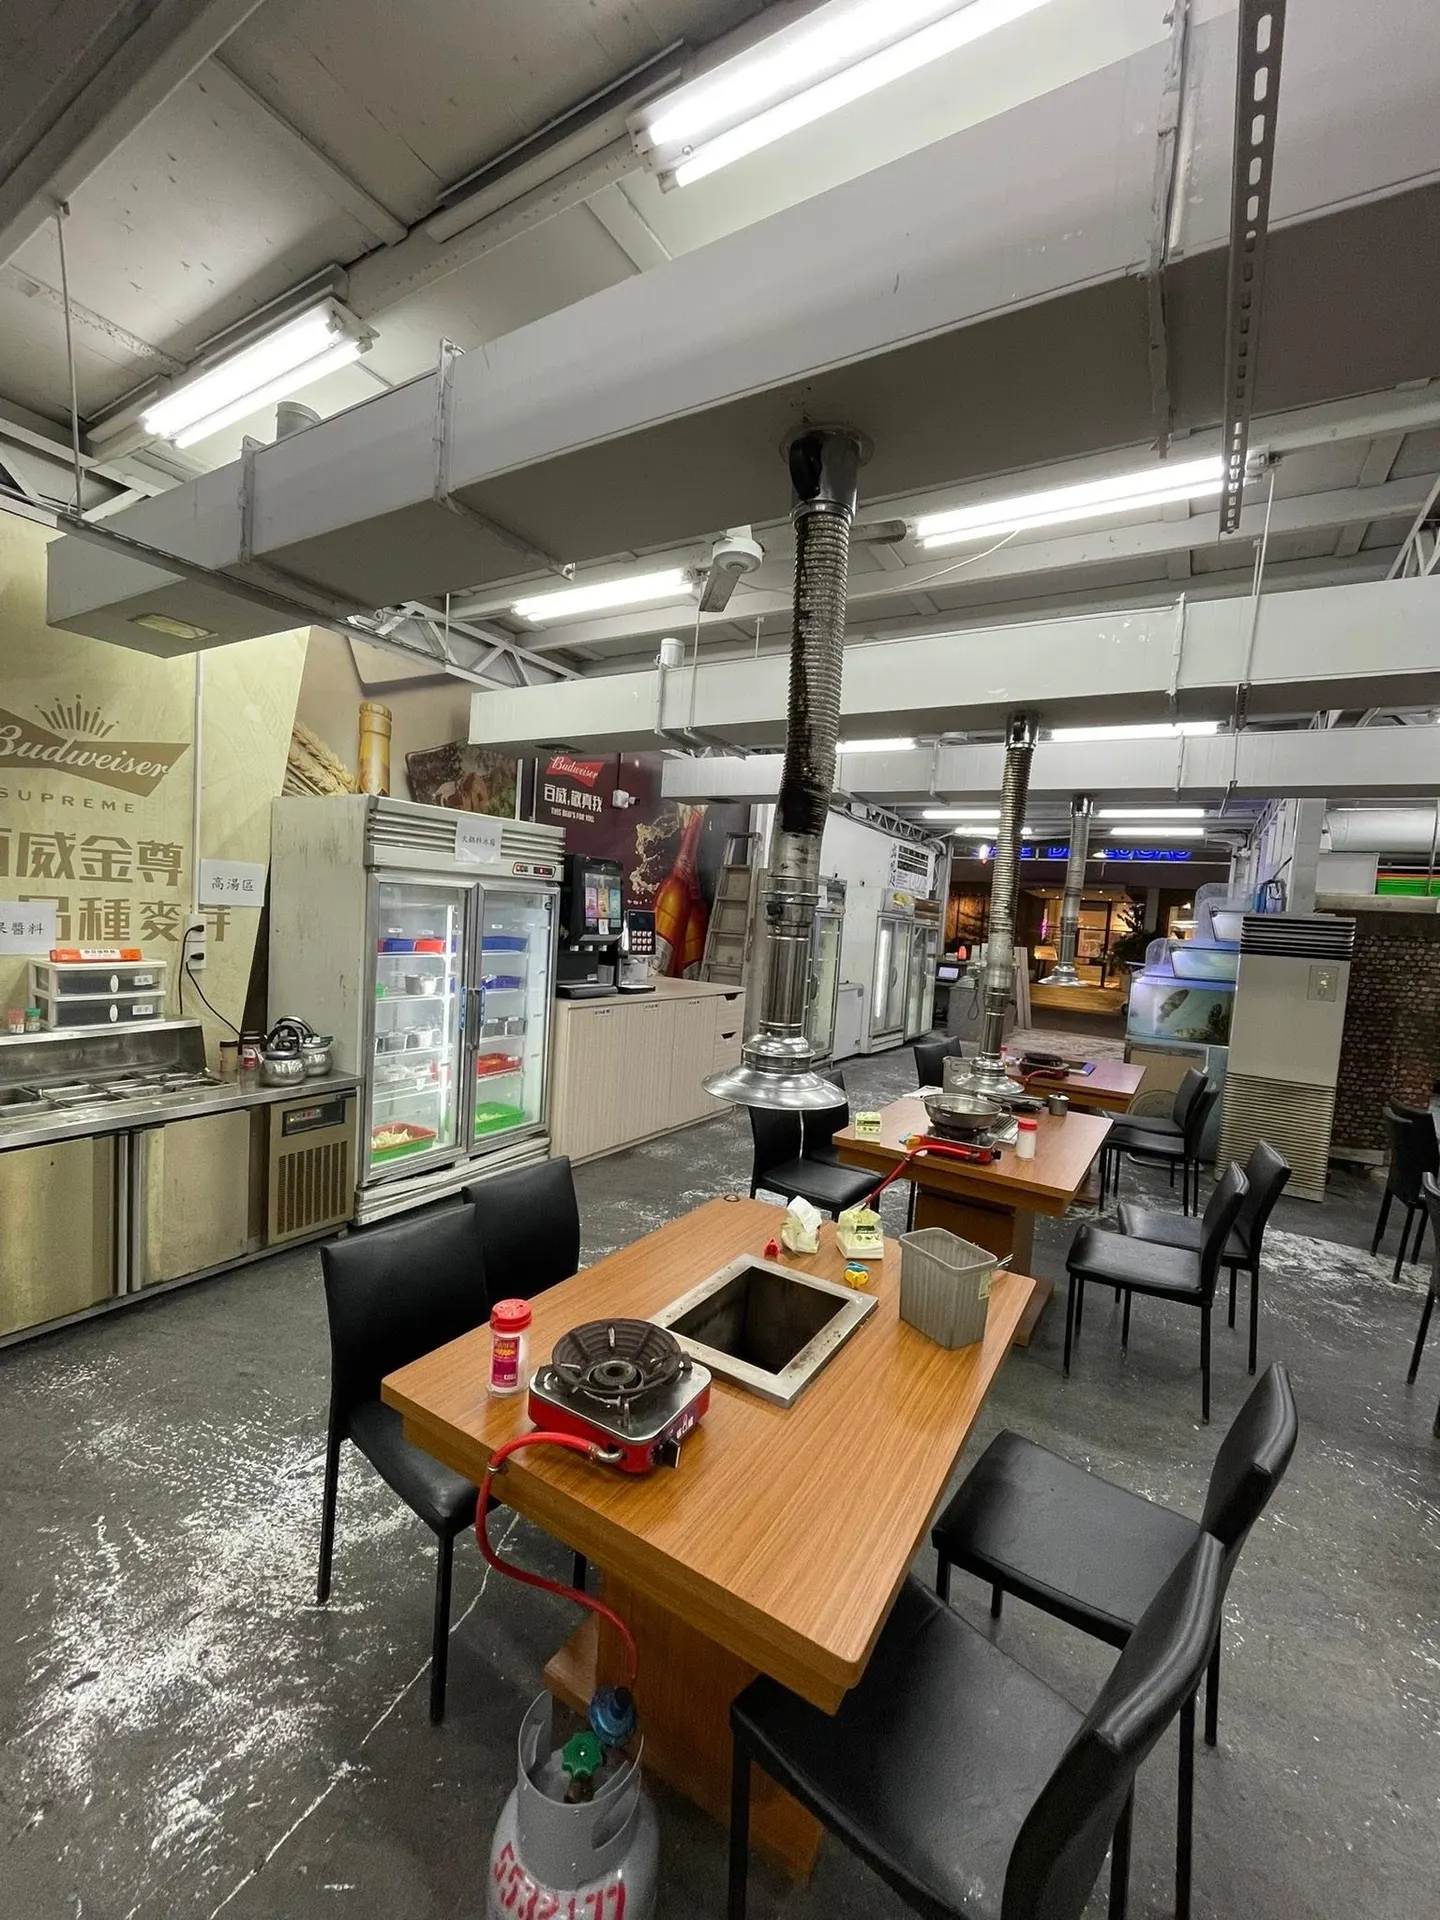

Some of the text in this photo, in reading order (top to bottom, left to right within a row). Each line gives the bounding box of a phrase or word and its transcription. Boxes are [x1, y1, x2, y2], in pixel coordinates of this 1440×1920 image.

[0, 725, 169, 777] Budweiser
[550, 756, 598, 779] Budweiser
[0, 787, 135, 813] SUPREME
[211, 876, 254, 892] 高湯區
